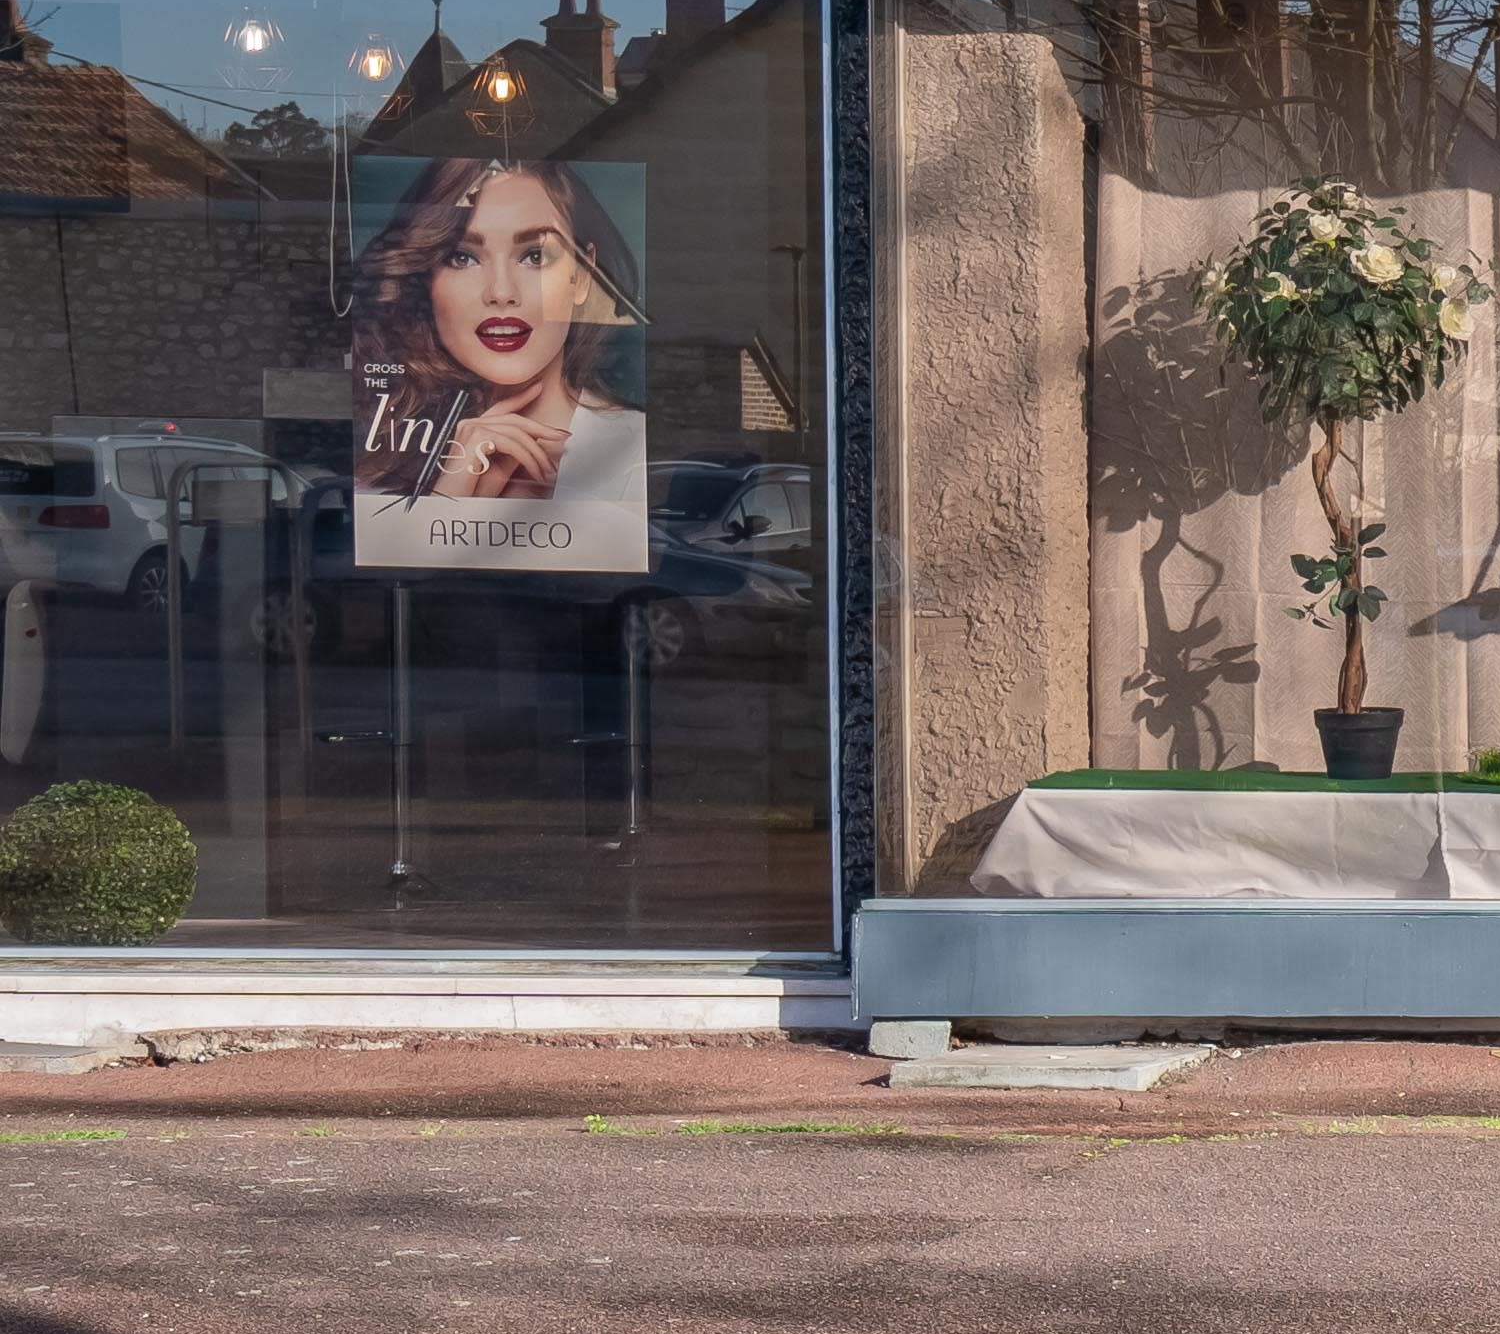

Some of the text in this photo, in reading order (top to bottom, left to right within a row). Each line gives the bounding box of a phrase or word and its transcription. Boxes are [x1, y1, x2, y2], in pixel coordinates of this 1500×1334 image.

[363, 362, 405, 375] CROSS
[364, 377, 388, 388] THE
[364, 393, 496, 476] lines
[429, 518, 573, 549] ARTDECO
